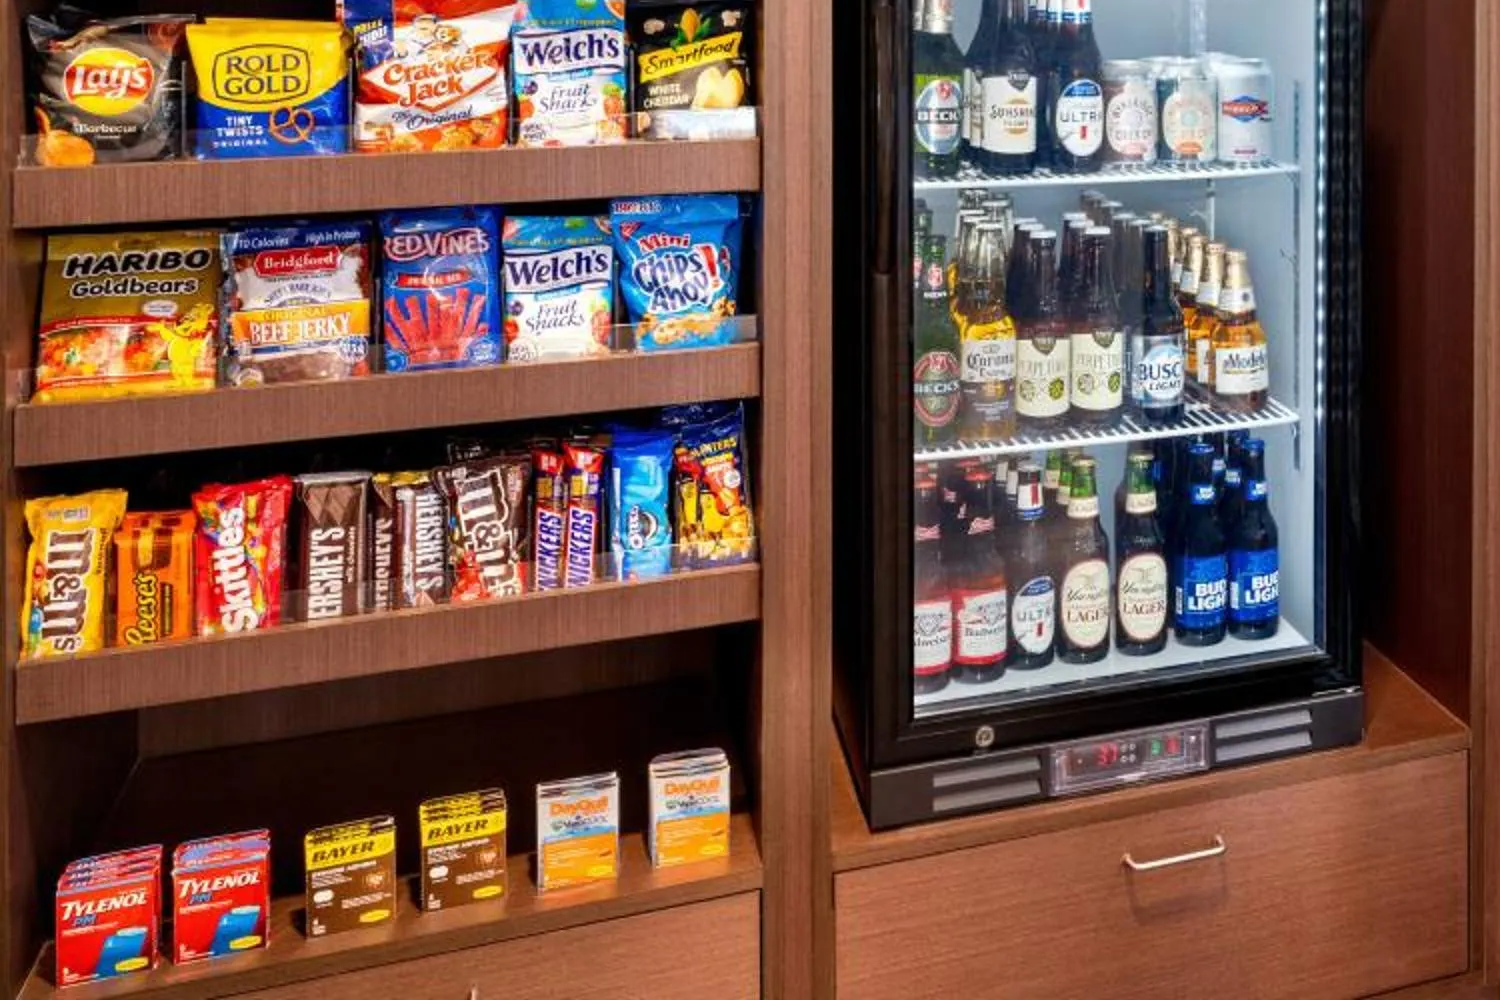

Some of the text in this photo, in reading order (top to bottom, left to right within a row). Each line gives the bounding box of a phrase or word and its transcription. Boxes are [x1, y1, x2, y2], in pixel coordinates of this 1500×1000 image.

[225, 54, 301, 73] ROLD
[521, 32, 620, 67] Welch's
[644, 37, 738, 76] Smartfood
[382, 51, 498, 86] Cracker
[223, 75, 302, 95] GOLD
[399, 75, 464, 108] Jack
[215, 126, 265, 138] TWISTS
[224, 115, 253, 126] TINY
[425, 228, 491, 257] VINES
[637, 232, 691, 253] Mini
[62, 248, 213, 279] HARIBO
[507, 249, 610, 286] Welch's
[633, 251, 703, 293] Chips
[70, 278, 200, 300] Goldbears
[250, 311, 351, 345] BEEF JERKY
[1138, 361, 1183, 381] BUSC
[537, 509, 564, 590] NICKERS
[567, 508, 596, 588] NICKERS
[307, 526, 345, 619] ERSHEY'S
[1195, 579, 1227, 598] BUD
[1245, 585, 1279, 605] LIGH
[1188, 595, 1227, 612] LIGH
[427, 818, 489, 840] BAYER
[311, 840, 376, 864] BAYER
[178, 870, 260, 899] TYLENOL
[61, 891, 148, 920] TYLENOL
